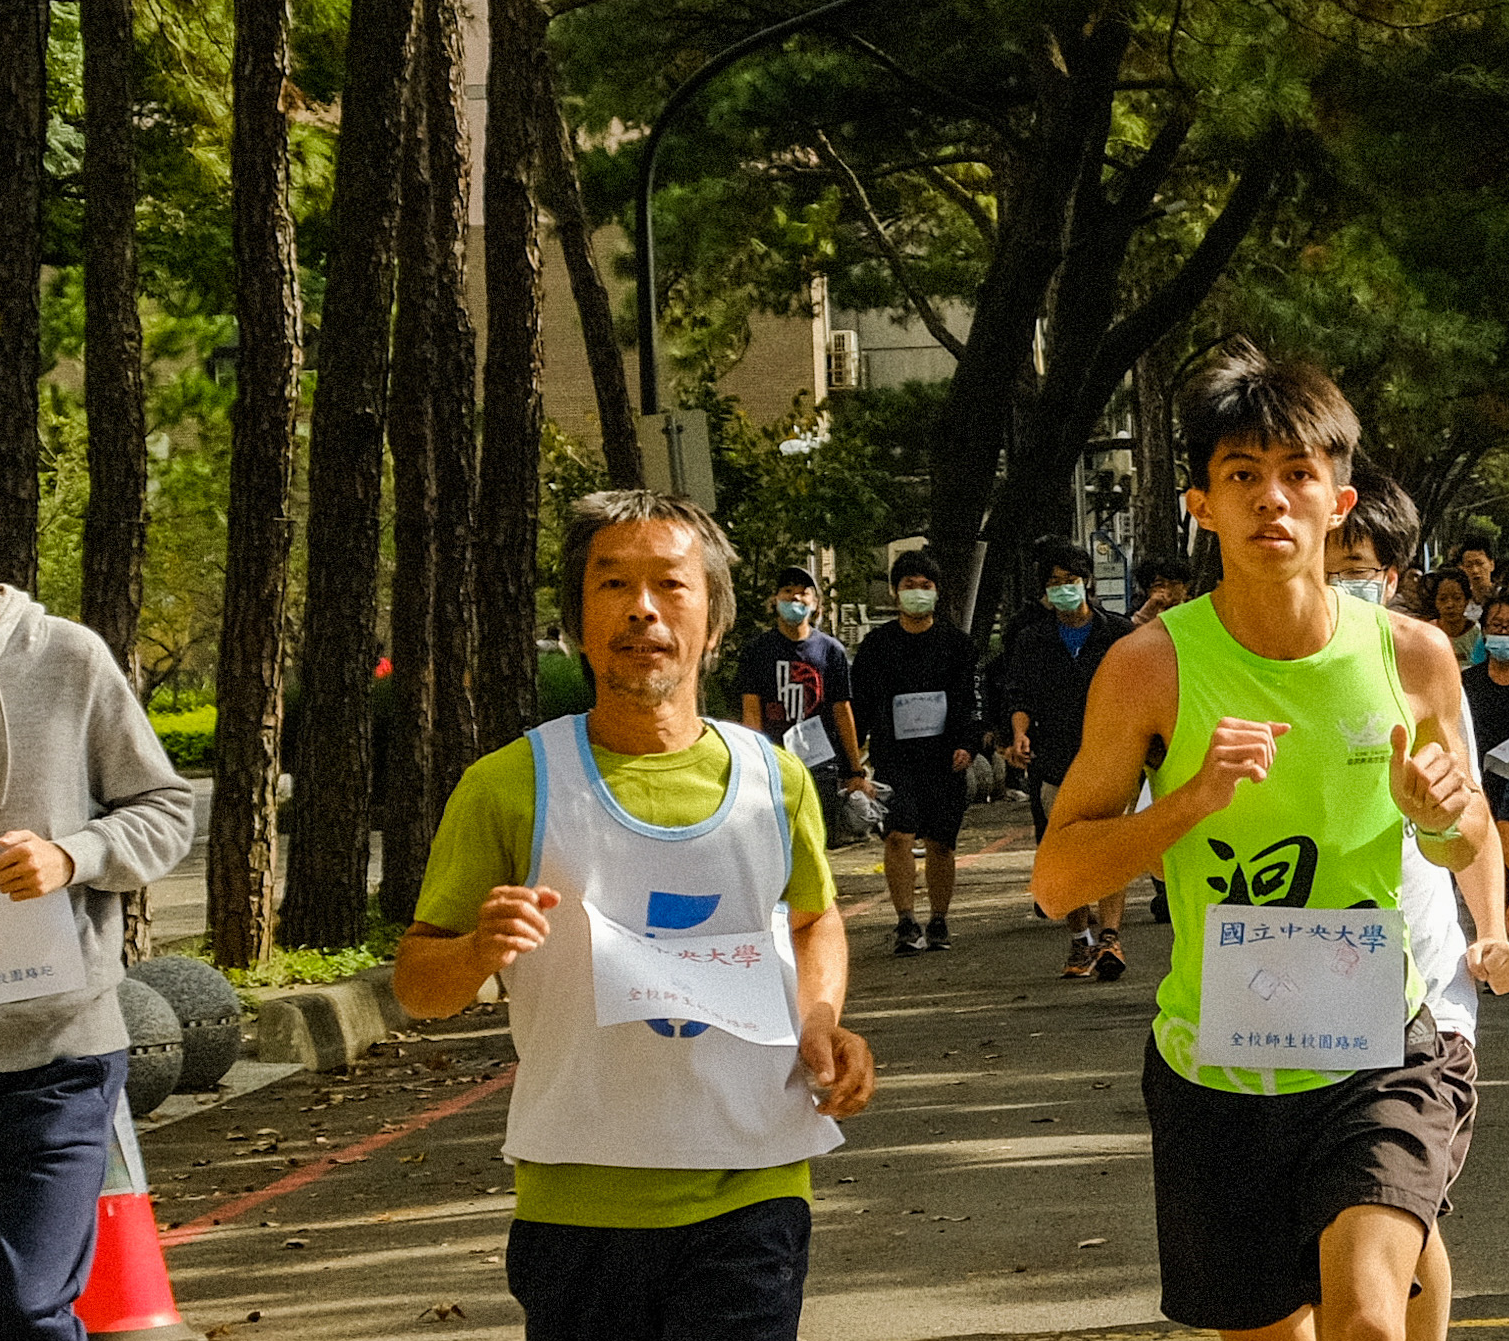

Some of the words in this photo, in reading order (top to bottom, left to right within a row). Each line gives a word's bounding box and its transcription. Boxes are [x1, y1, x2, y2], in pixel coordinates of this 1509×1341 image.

[1219, 921, 1388, 954] 國立中央大學
[1229, 1032, 1369, 1051] 全校師生校園路跑
